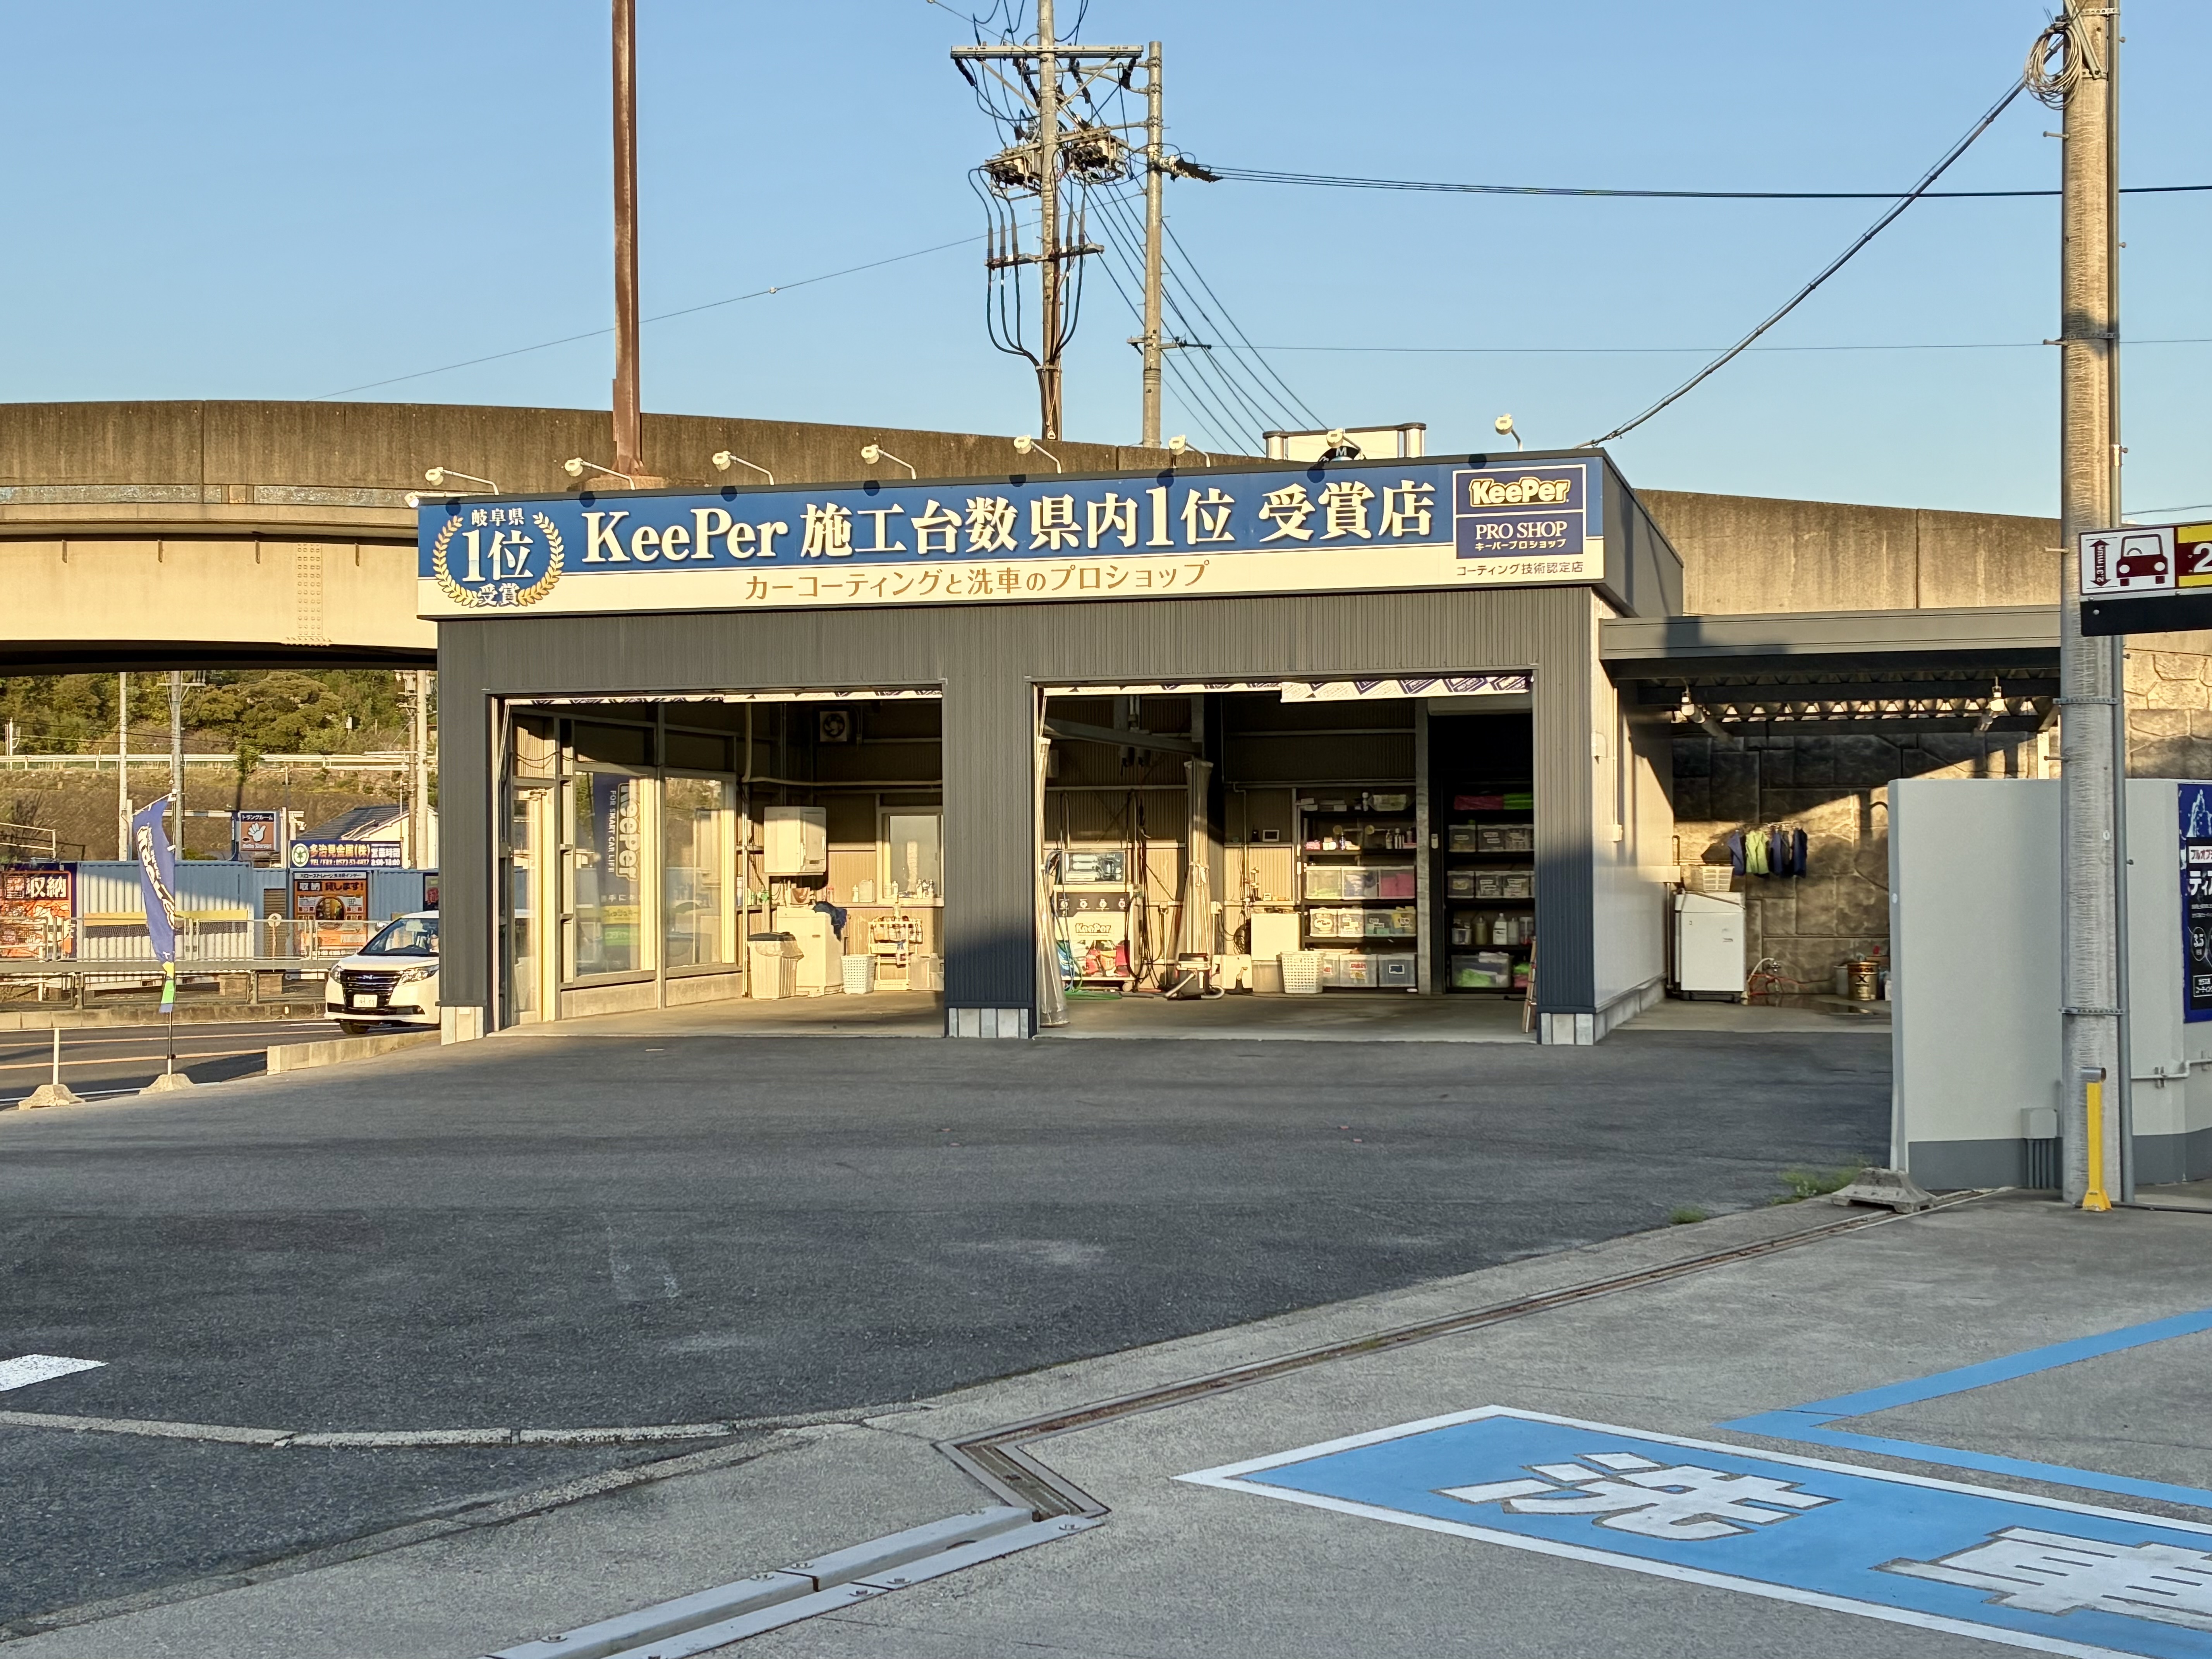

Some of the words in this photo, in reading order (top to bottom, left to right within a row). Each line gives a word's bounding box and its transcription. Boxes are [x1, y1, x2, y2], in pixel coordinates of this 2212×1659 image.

[1470, 477, 1570, 506] KeePer
[471, 508, 525, 526] 岐阜県
[581, 508, 788, 563] KeePer
[799, 486, 1237, 558] 施工台数県内1位
[1259, 480, 1436, 543] 受賞店
[1475, 523, 1513, 540] PRO
[1516, 520, 1568, 539] SHOP
[462, 528, 534, 582] 1位
[1475, 538, 1567, 551] キーパープロショップ
[1456, 561, 1584, 576] コーティング技術認定店
[745, 560, 1211, 601] カーコーティングと洗車のプロショップ
[478, 582, 520, 607] 受賞
[608, 808, 617, 835] SMART
[608, 836, 616, 852] CAR
[26, 876, 66, 898] 収納
